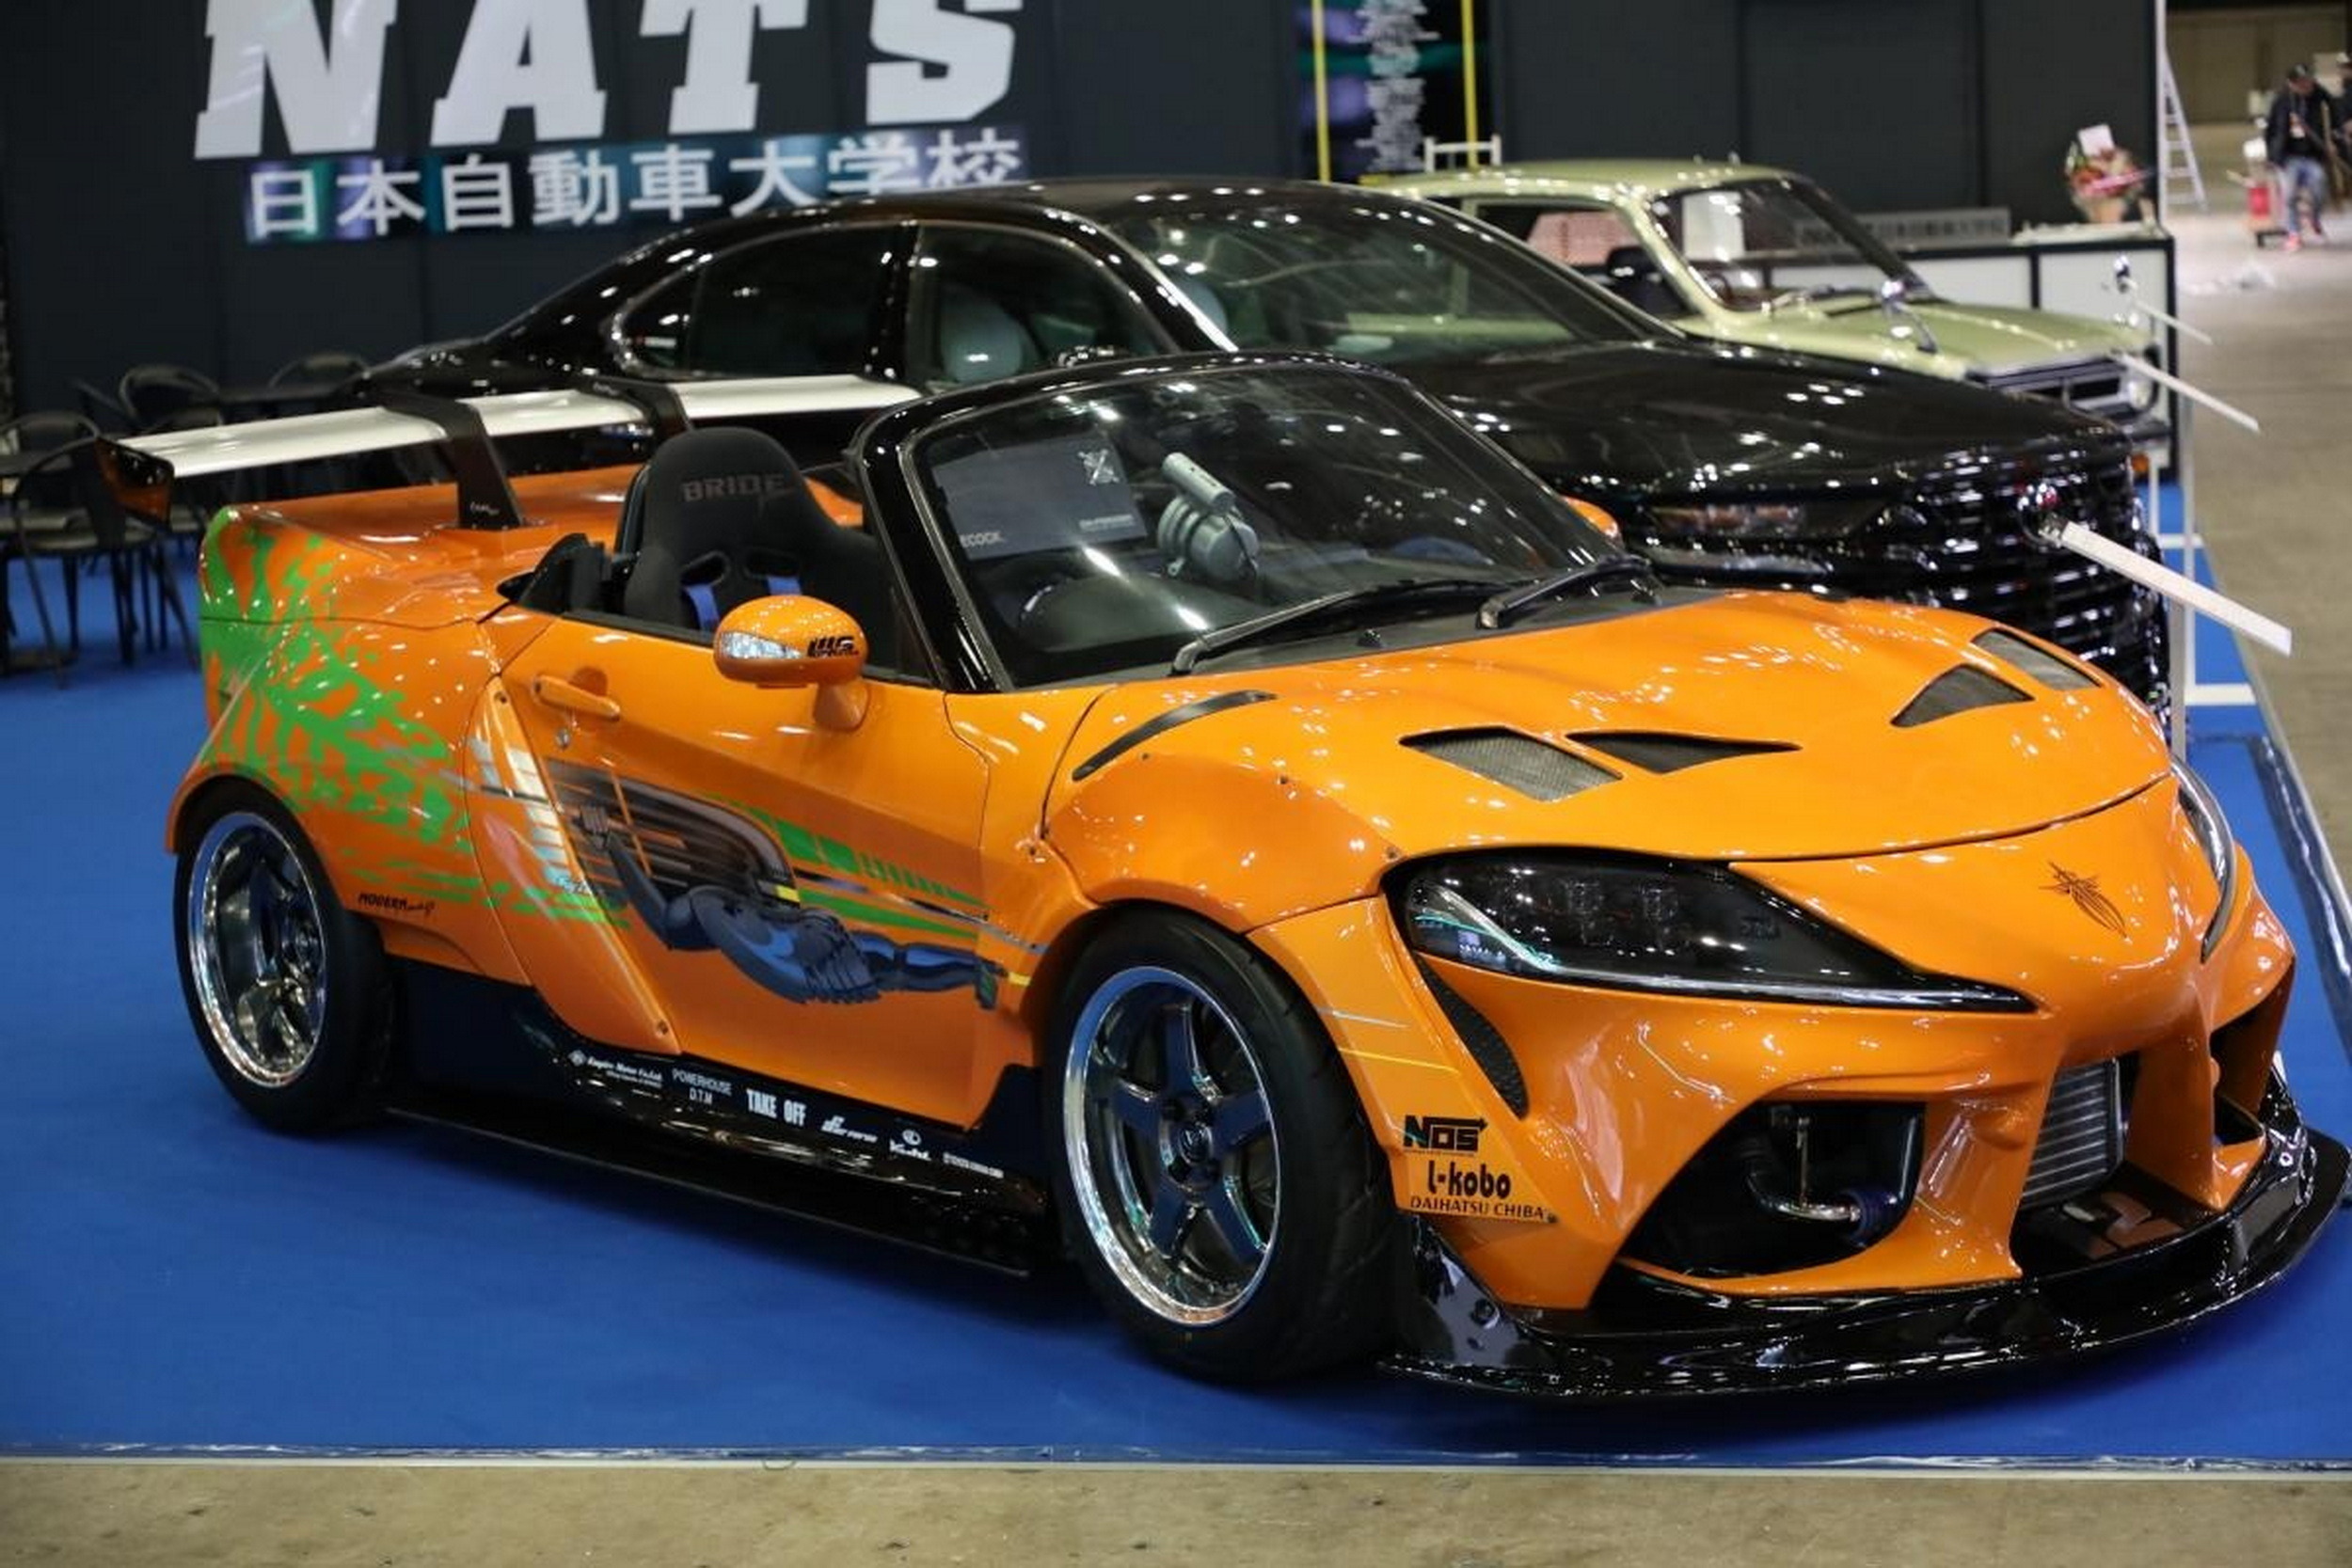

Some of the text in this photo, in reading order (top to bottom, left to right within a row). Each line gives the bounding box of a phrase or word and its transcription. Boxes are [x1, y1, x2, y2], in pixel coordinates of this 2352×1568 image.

[195, 0, 1023, 158] NATS
[250, 127, 1020, 239] 日本自動車大学校
[681, 473, 788, 503] BRIDE
[672, 1068, 732, 1097] POWERHOUSE
[746, 1087, 806, 1127] TAKE OFF
[1403, 1115, 1487, 1152] NOS
[1410, 1196, 1545, 1219] DAIHATSU CHIBA
